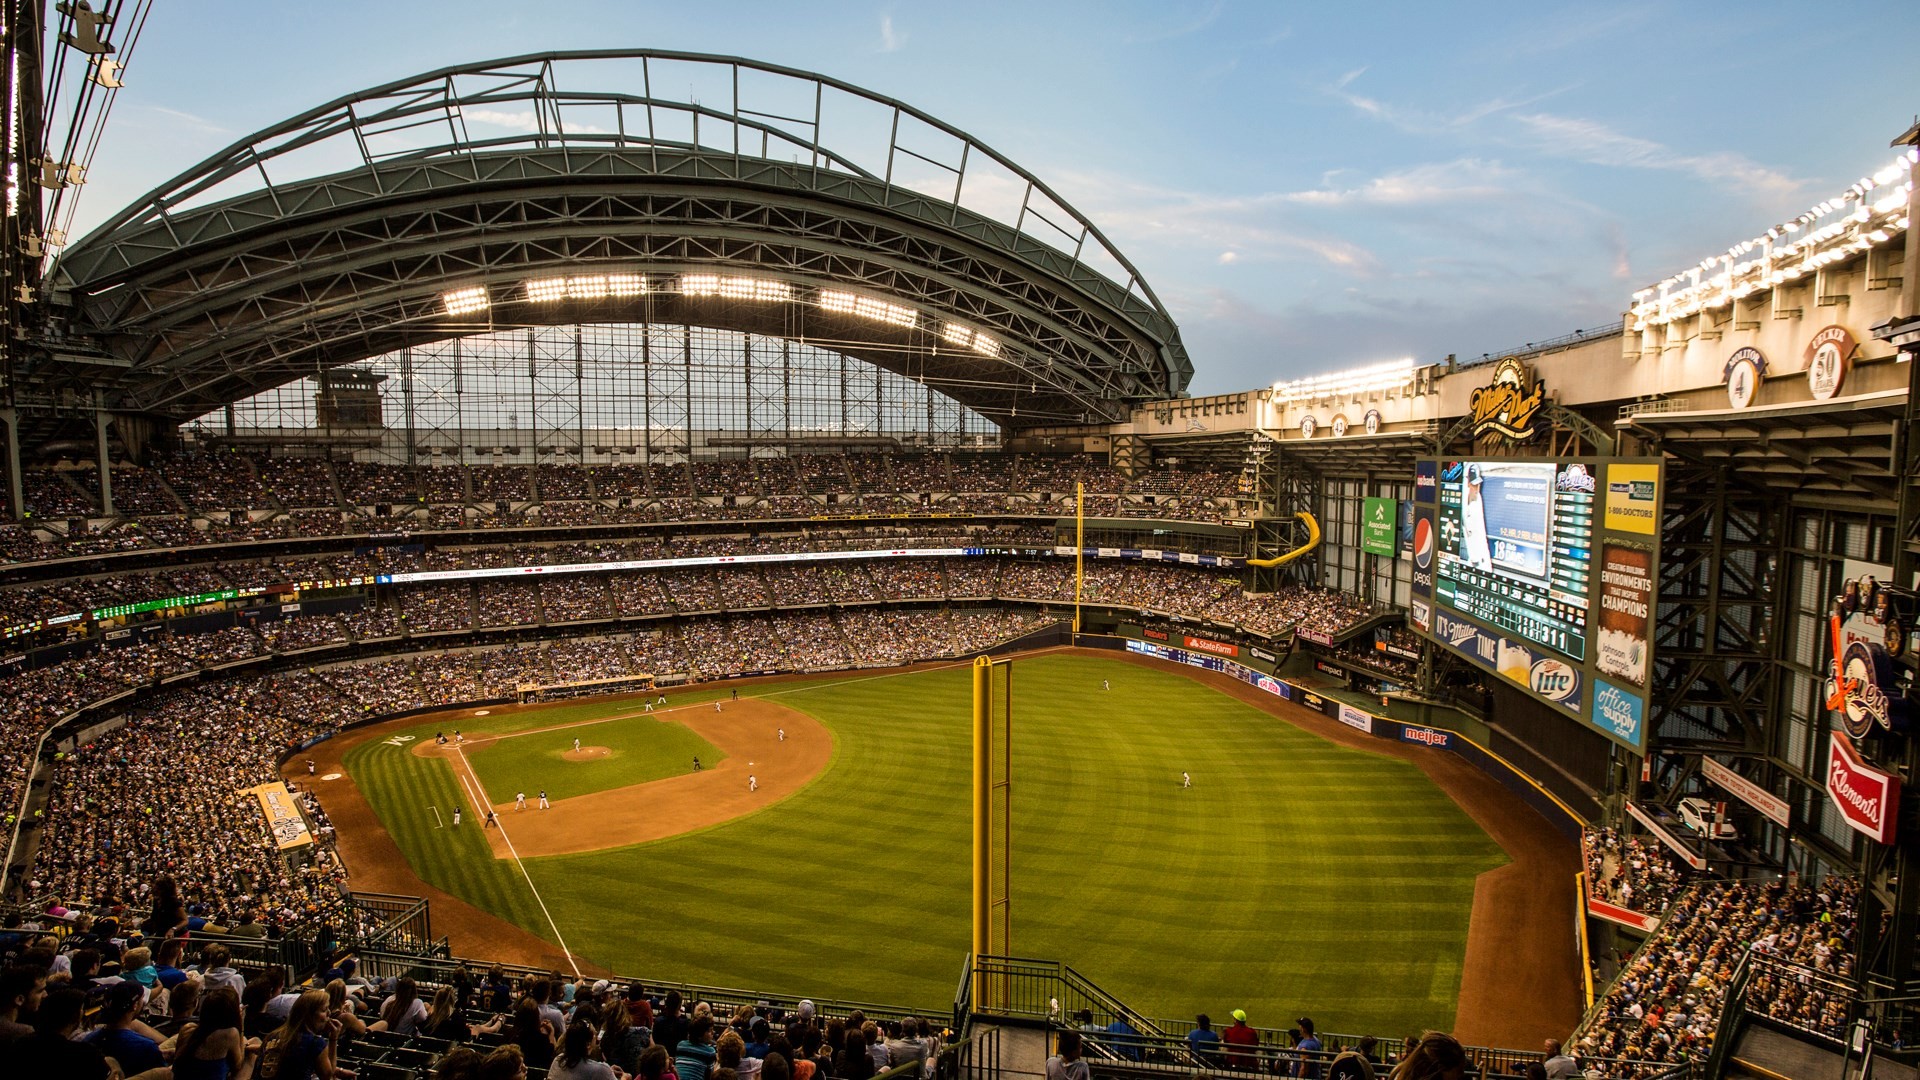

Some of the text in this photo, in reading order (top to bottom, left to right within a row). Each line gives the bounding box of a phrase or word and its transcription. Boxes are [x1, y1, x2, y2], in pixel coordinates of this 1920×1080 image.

[1812, 328, 1846, 350] UECKER
[1729, 349, 1760, 369] MOLITOR
[1735, 372, 1744, 399] 4
[1470, 382, 1542, 427] Miller Park
[1304, 424, 1312, 434] 34
[1335, 422, 1342, 432] 42
[1368, 420, 1376, 431] 44
[1608, 506, 1654, 518] 1-800-DOCTORS
[1368, 520, 1391, 530] Associated
[1494, 541, 1505, 560] 18
[1608, 562, 1646, 576] CREATING BUILDING
[1414, 571, 1432, 586] pepsi
[1602, 570, 1652, 592] ENVIRONMENTS
[1610, 586, 1639, 600] THAT INSPIRE
[1602, 594, 1648, 618] CHAMPIONS
[1144, 630, 1168, 640] FRIDAYS
[1436, 614, 1496, 662] IT'S Miller TIME
[1542, 626, 1565, 649] 3 1 1
[1602, 643, 1626, 658] Johnson
[4, 655, 26, 664] SECTION
[1606, 655, 1629, 672] Controls
[1322, 662, 1342, 676] impact
[1537, 672, 1570, 695] Lite
[1598, 688, 1632, 714] office
[1604, 706, 1636, 733] supply
[1405, 728, 1448, 746] meijer
[1614, 726, 1630, 739] .com
[1831, 760, 1878, 823] Klement's
